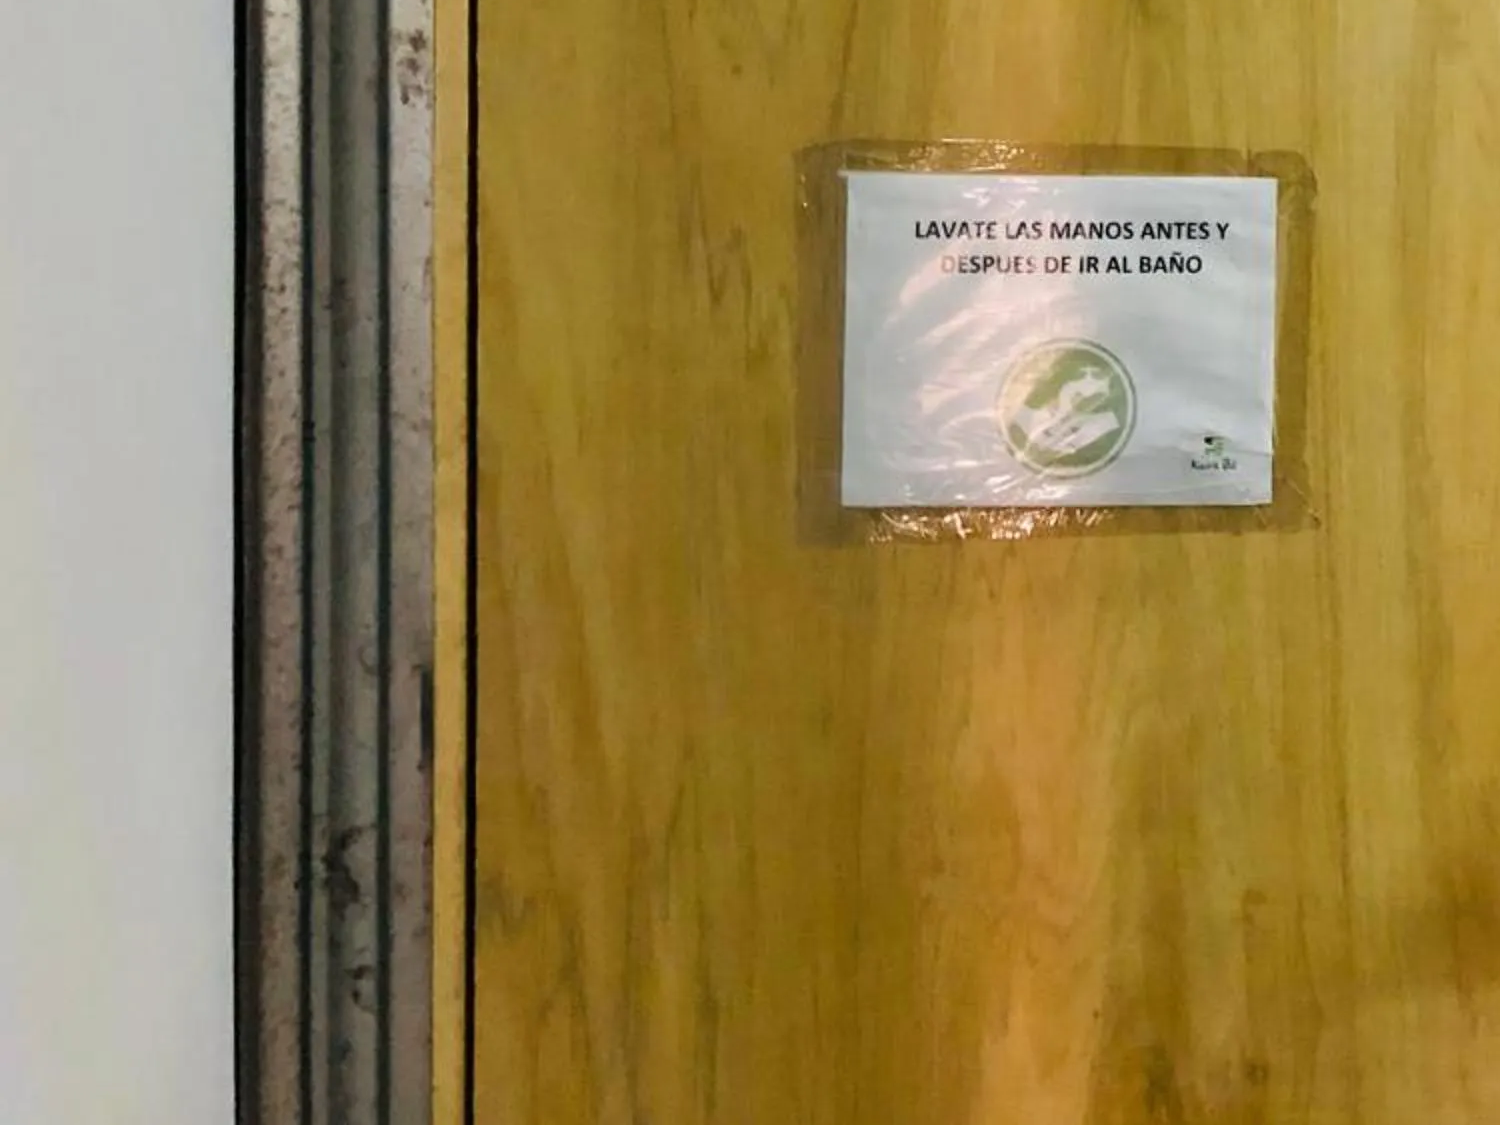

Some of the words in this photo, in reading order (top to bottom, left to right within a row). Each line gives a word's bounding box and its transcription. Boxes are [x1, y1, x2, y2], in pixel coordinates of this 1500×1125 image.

[914, 220, 997, 239] LAVATE
[1005, 220, 1043, 240] LAS
[1049, 220, 1134, 240] MANOS
[1139, 220, 1210, 240] ANTES
[1215, 221, 1230, 240] Y
[941, 255, 1037, 274] DESPUES
[1043, 255, 1072, 274] DE
[1078, 255, 1100, 274] IR
[1104, 255, 1133, 274] AL
[1138, 251, 1203, 275] BAÑO
